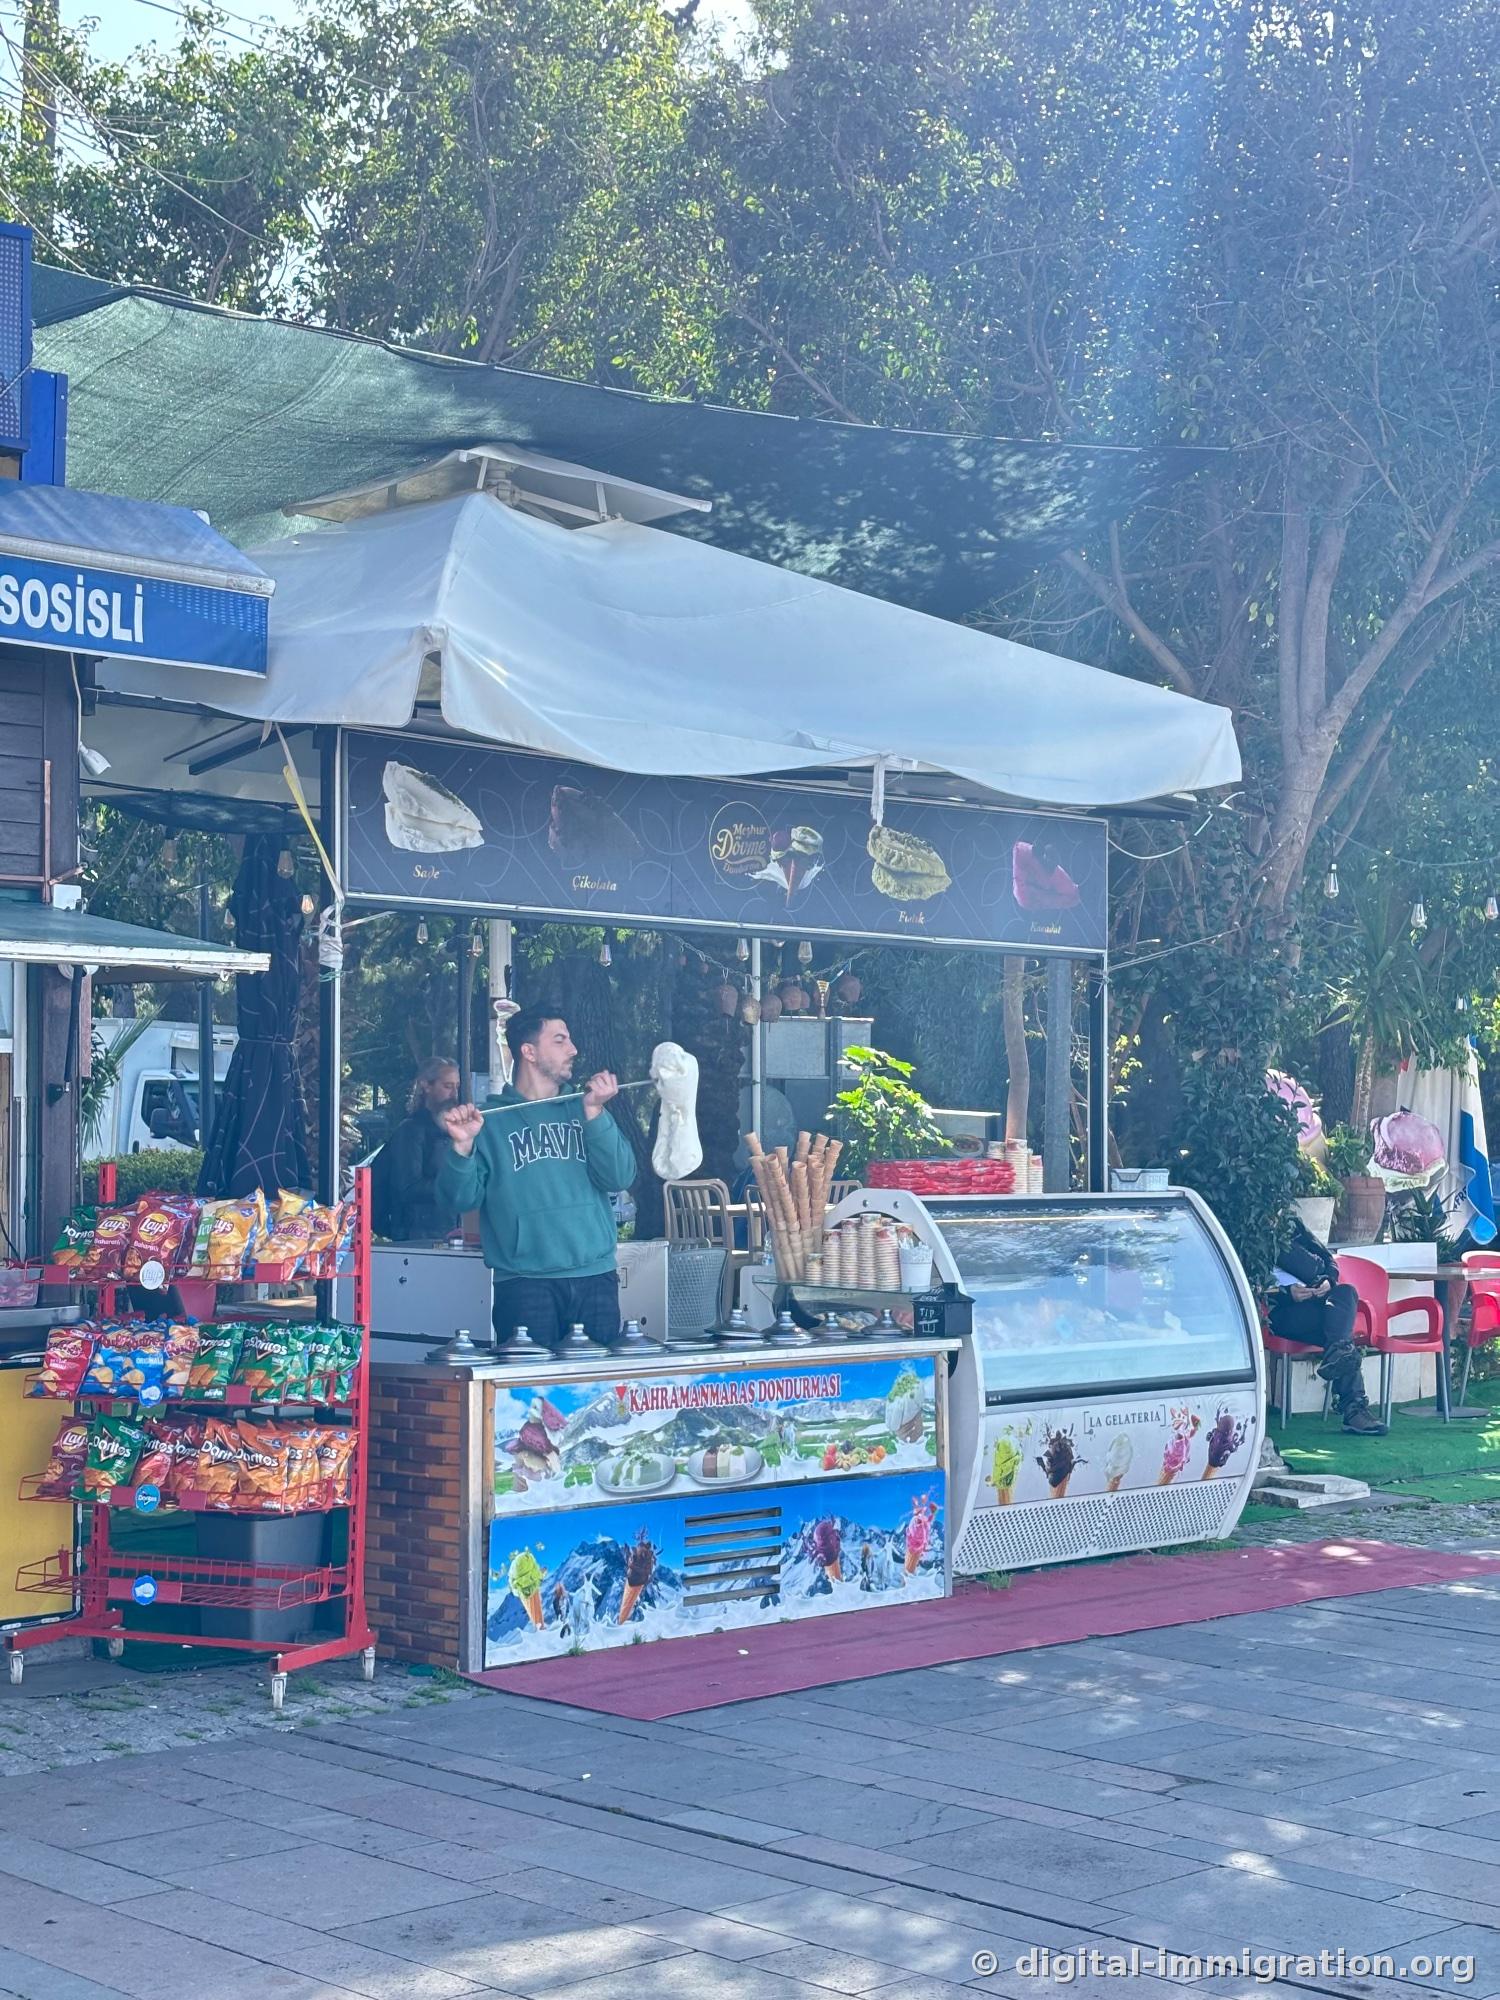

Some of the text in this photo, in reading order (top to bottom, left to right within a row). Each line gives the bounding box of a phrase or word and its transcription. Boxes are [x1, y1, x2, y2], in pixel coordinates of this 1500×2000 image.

[0, 574, 144, 643] SOSİSLİ
[413, 864, 440, 879] Sade
[572, 875, 617, 891] Çikolata
[508, 1119, 587, 1172] MAVİ
[139, 1216, 167, 1235] Lay's
[757, 1373, 842, 1404] DONDURMASI
[1089, 1410, 1161, 1428] LA GELATERIA
